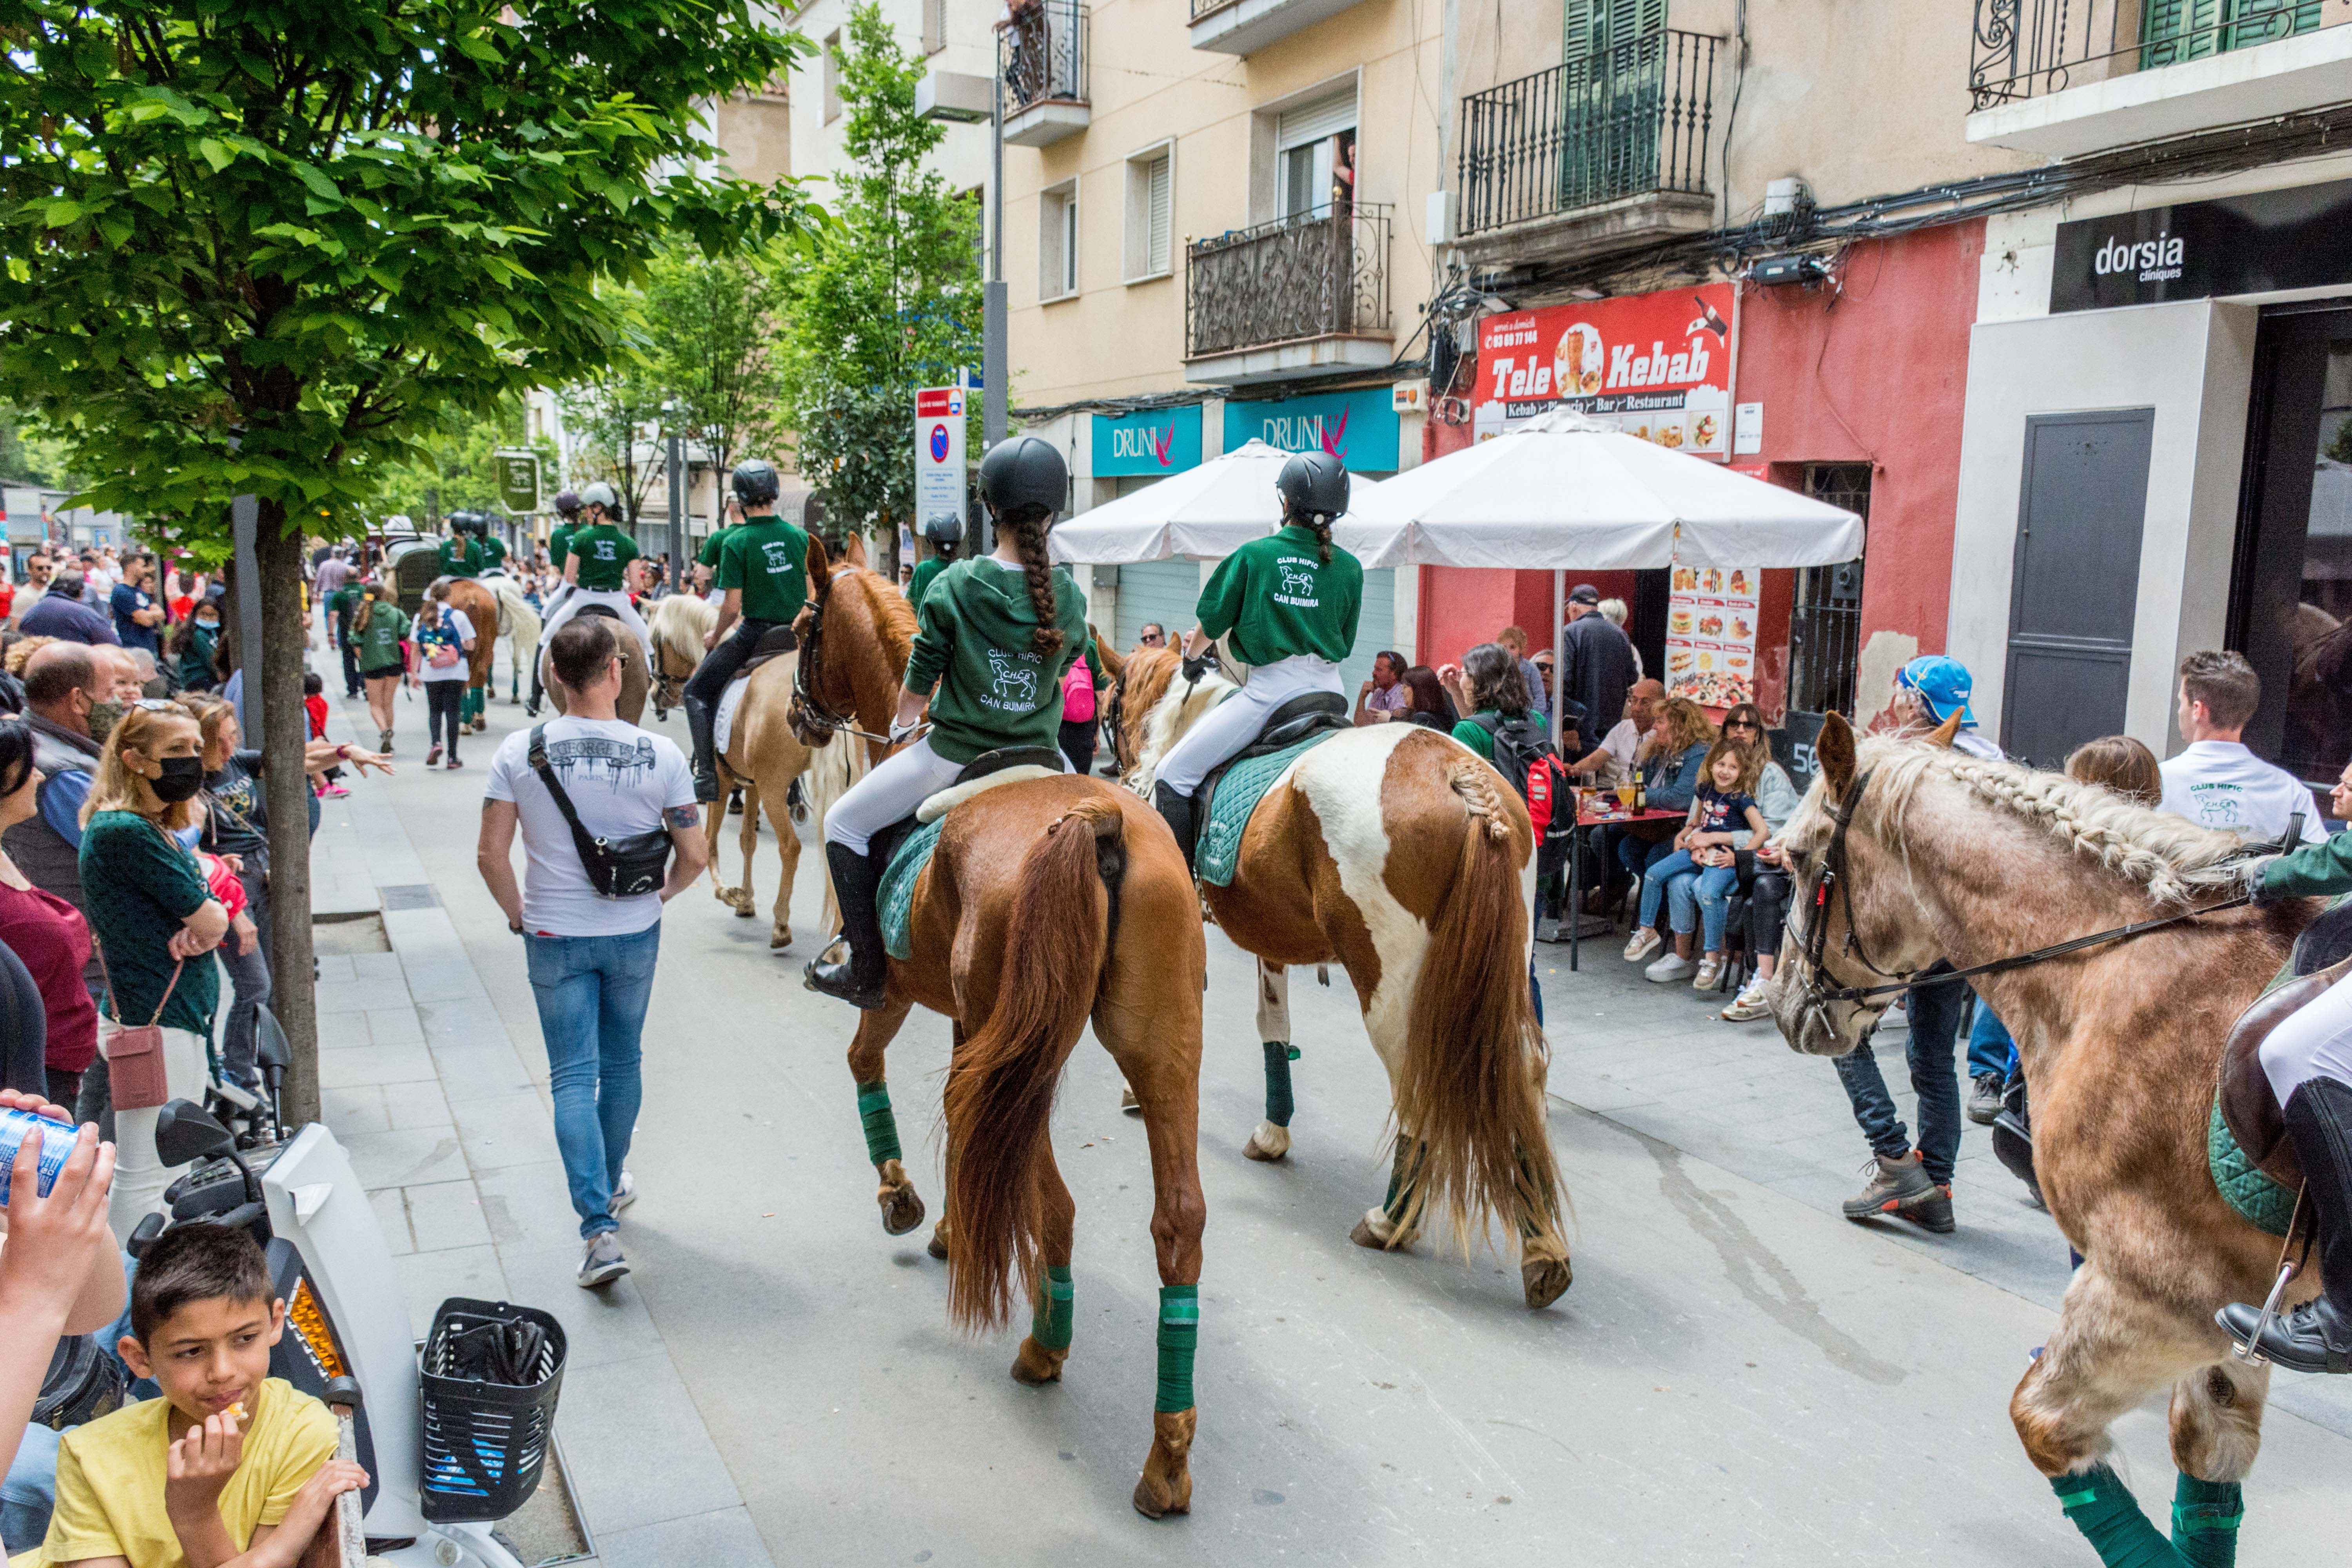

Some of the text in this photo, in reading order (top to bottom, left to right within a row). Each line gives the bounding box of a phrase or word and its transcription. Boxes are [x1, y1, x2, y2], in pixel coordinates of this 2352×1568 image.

[2095, 231, 2183, 275] dorsia
[1492, 337, 1710, 398] Tele Kebab
[1508, 404, 1536, 417] Kebab
[1596, 397, 1614, 412] Bar
[1626, 394, 1684, 410] Restaurant
[1113, 426, 1156, 457] DRUNI
[1263, 414, 1323, 450] DRUNI
[1298, 557, 1319, 569] HIPIC
[1274, 592, 1319, 607] CAN BUIMIRA
[1018, 652, 1043, 664] HIPIC
[980, 694, 1036, 712] CAN BUIMIRA
[2190, 783, 2243, 792] CLUB HIPIC
